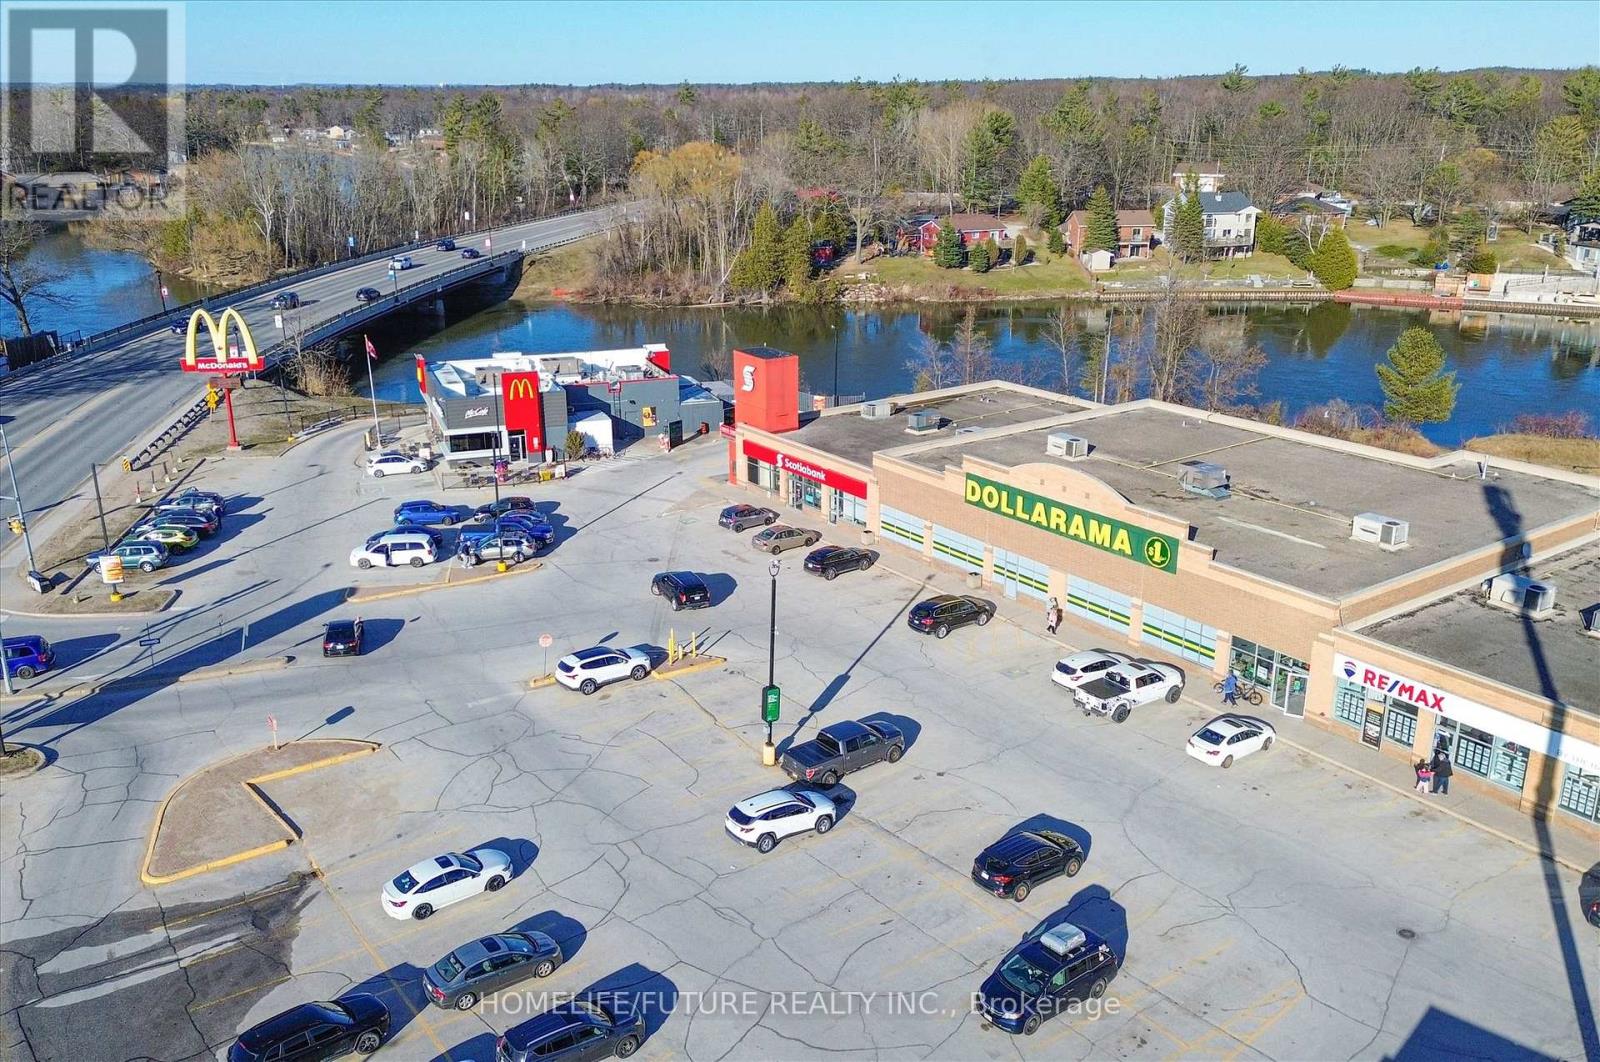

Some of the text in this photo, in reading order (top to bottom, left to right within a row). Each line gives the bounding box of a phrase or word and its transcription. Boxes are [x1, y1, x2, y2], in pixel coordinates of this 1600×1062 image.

[197, 362, 249, 370] McDonald's
[784, 458, 826, 480] Scotiabank
[966, 479, 1132, 556] DOLLARAMA
[1363, 669, 1445, 712] RE/MAX
